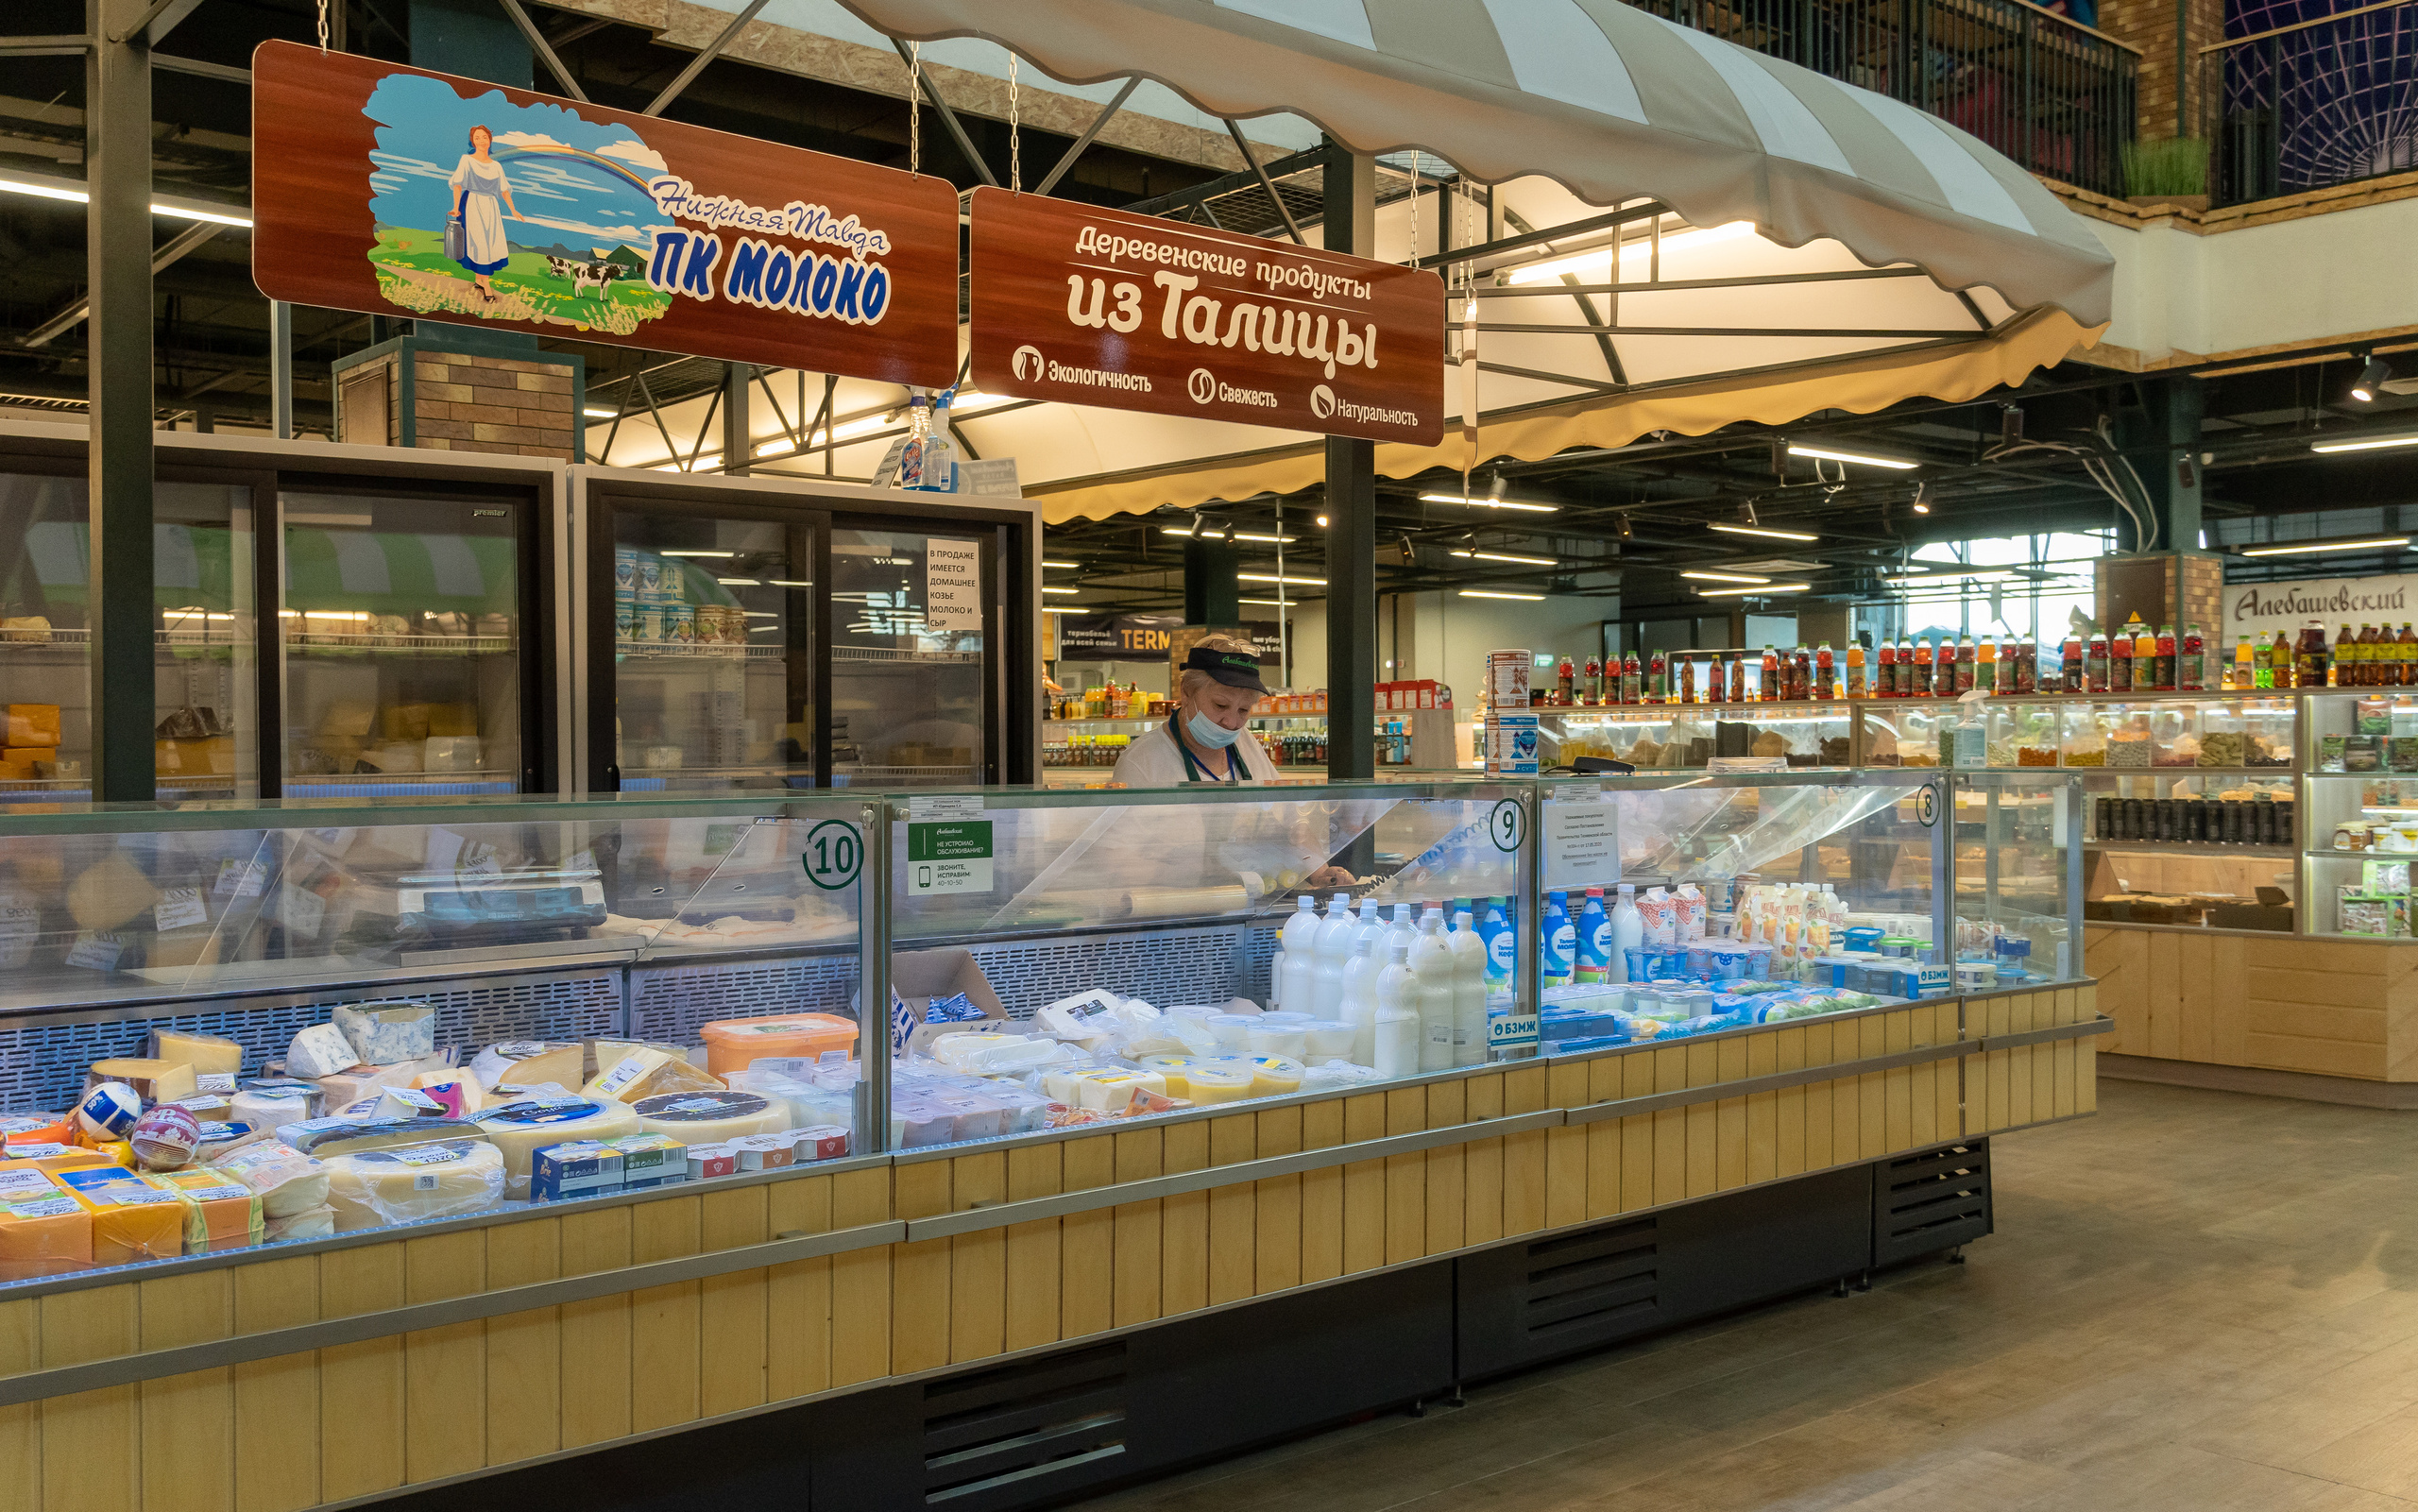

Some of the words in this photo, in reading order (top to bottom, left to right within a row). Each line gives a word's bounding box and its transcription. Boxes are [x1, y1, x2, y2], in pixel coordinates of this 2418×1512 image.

[653, 180, 785, 230] Нижняя
[788, 206, 887, 255] Тавда
[1075, 225, 1247, 278] Деревенские
[1256, 259, 1372, 302] продукты
[650, 232, 718, 297] ПК
[727, 242, 888, 320] МОЛОКО
[1067, 274, 1143, 333] из
[1153, 269, 1379, 380] Талицы
[1047, 359, 1152, 395] Экологичность
[1218, 380, 1279, 409] Свежесть
[1337, 398, 1419, 428] Натуральность
[473, 509, 506, 518] premier
[936, 550, 975, 560] ПРОДАЖЕ
[929, 564, 965, 573] ИМЕЕТСЯ
[929, 577, 976, 587] ДОМАШНЕЕ
[929, 591, 954, 600] КОЗЬЕ
[929, 605, 966, 614] МОЛОКО
[966, 606, 973, 615] И
[2234, 585, 2406, 622] Алебашевский
[929, 619, 946, 627] СЫР
[1120, 629, 1170, 651] TERM
[1924, 793, 1933, 819] 8
[1502, 809, 1514, 841] 9
[936, 846, 984, 856] ОБСЛУЖИВАНИЕ?
[945, 840, 974, 848] УСТРОИЛО
[813, 835, 854, 875] 10
[937, 863, 966, 872] ЗВОНИТЕ,
[937, 878, 963, 887] 40-10-50
[1928, 969, 1950, 980] БЗМЖ
[1505, 1020, 1537, 1035] БЗМЖ
[86, 1094, 104, 1112] 50%
[744, 1136, 782, 1147] BRIE
